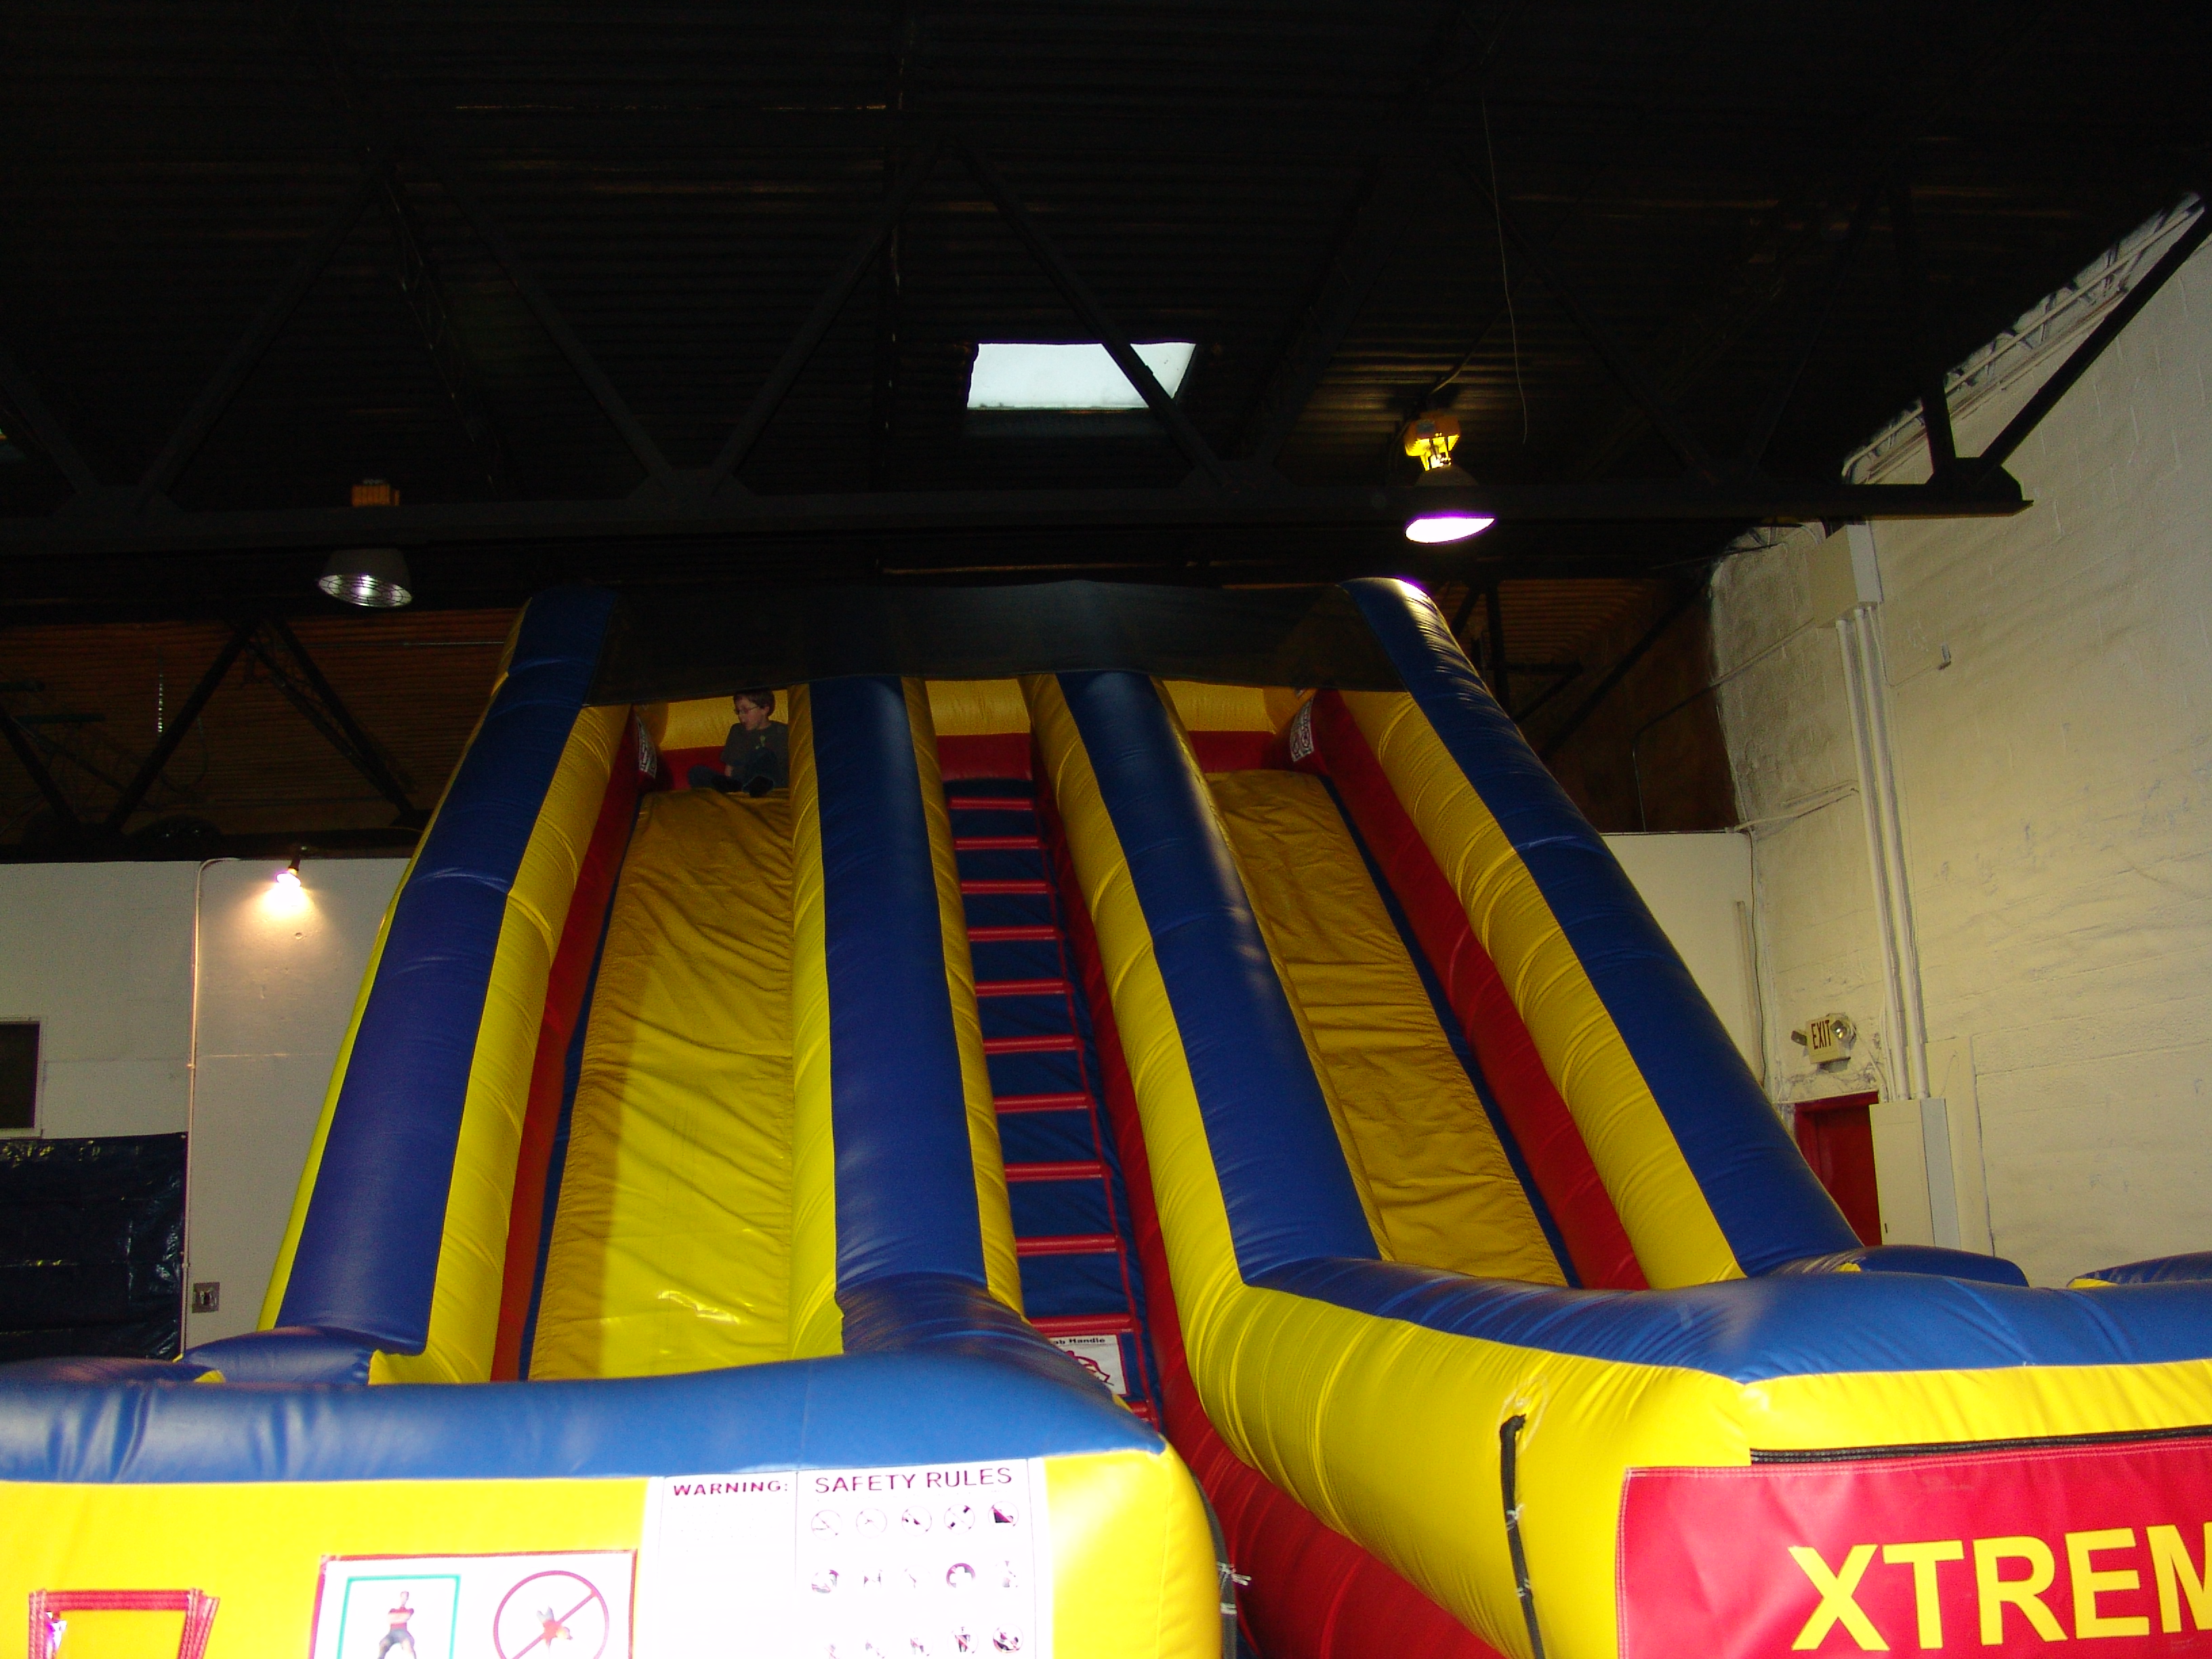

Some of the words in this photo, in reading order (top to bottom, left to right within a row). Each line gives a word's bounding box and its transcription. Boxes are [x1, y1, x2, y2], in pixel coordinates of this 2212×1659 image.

[1811, 1019, 1831, 1050] EXIT
[673, 1479, 788, 1496] WARNING:
[815, 1472, 917, 1494] SAFETY
[926, 1467, 1012, 1488] RULES
[1788, 1521, 2212, 1651] XTREM
